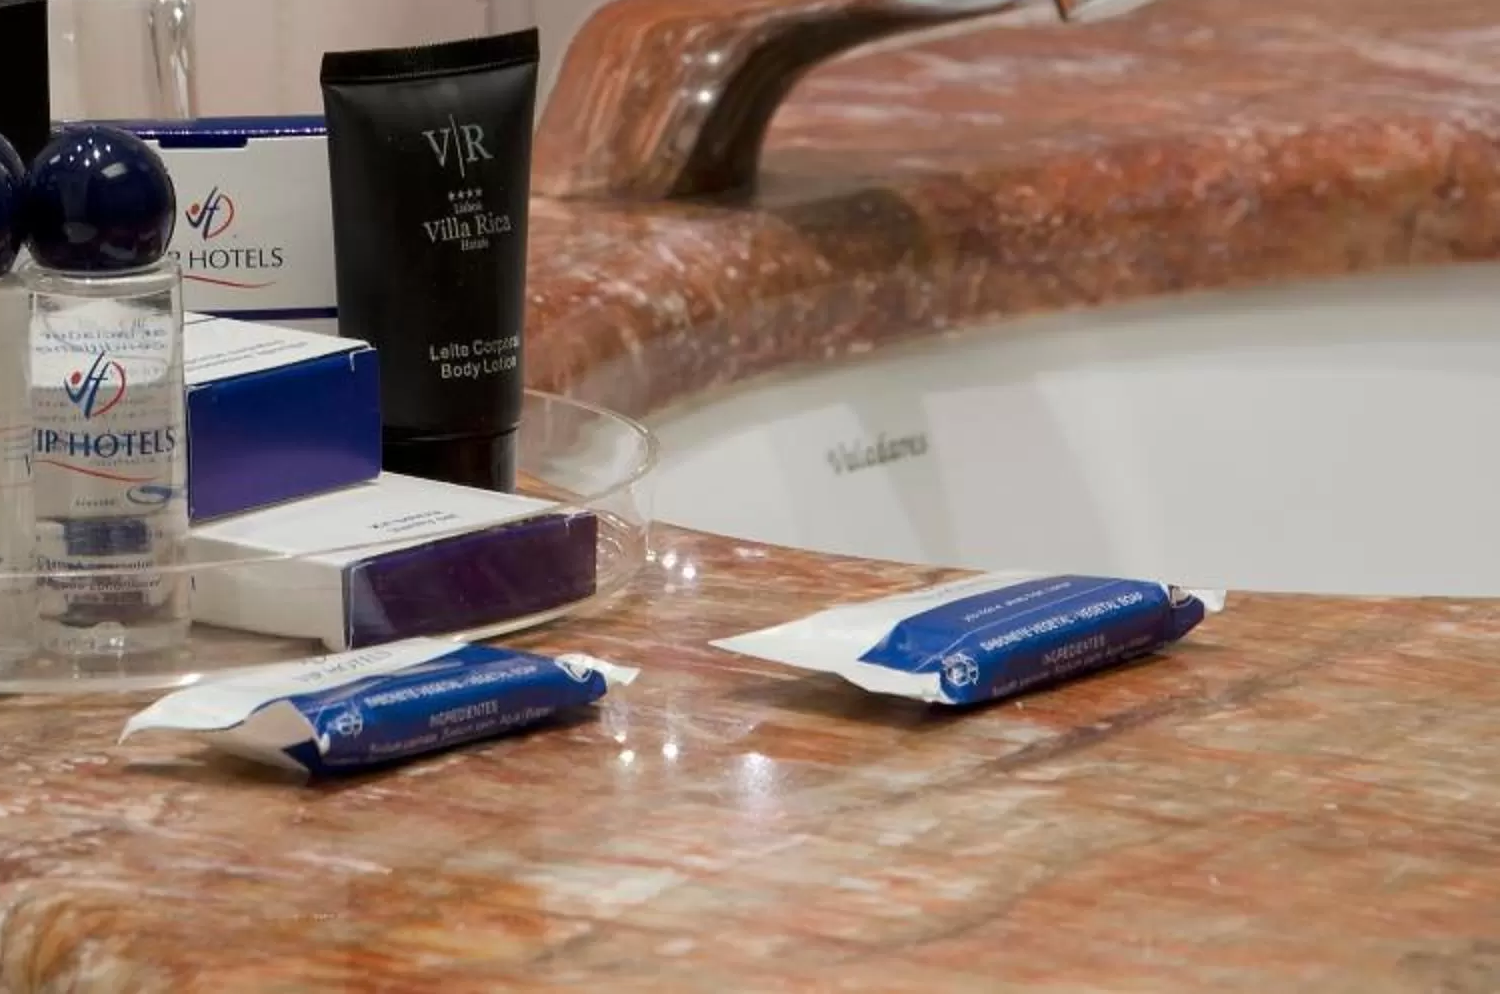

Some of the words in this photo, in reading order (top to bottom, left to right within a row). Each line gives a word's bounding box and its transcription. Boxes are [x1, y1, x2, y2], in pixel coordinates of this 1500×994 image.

[422, 216, 472, 244] Villa
[475, 211, 512, 236] Rica
[188, 247, 284, 270] HOTELS
[441, 360, 481, 381] Body
[68, 426, 176, 458] HOTELS
